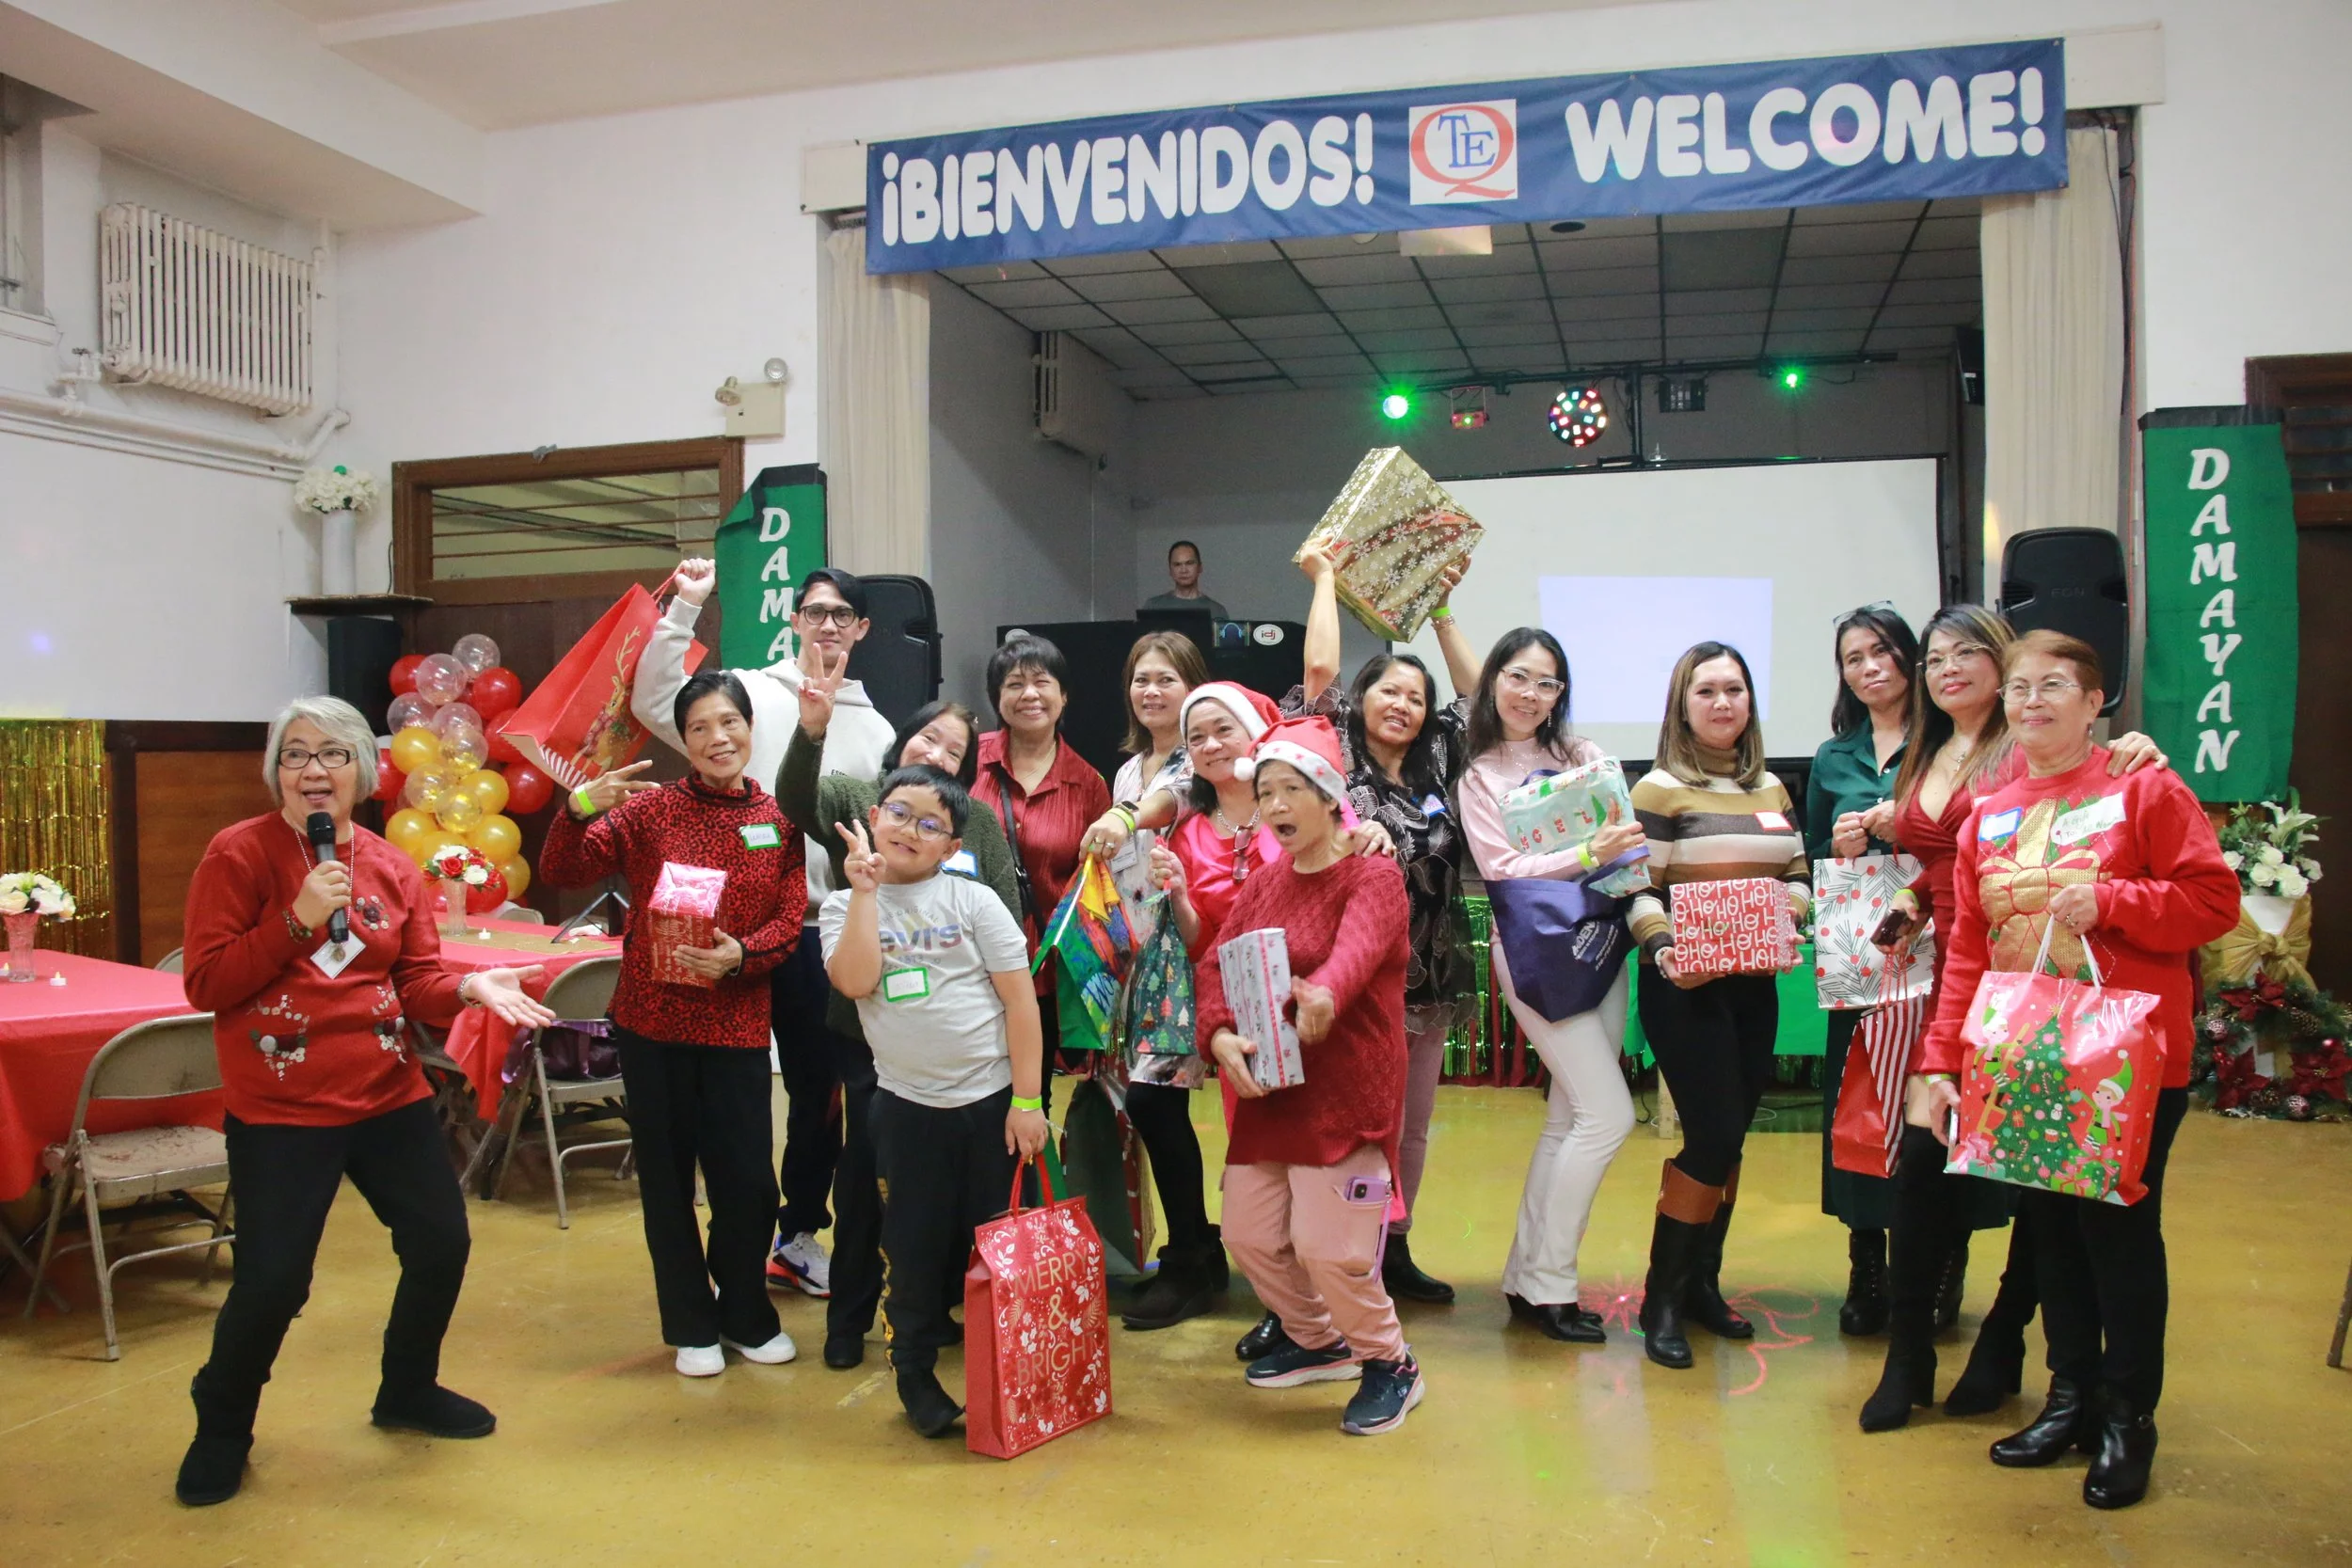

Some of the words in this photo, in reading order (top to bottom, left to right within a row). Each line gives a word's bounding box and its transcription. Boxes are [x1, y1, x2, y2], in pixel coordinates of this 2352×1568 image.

[1565, 66, 2046, 183] WELCOME!
[882, 112, 1374, 246] ¡BIENVENIDOS!
[2187, 448, 2243, 774] DAMAYAN
[1015, 1246, 1089, 1298] MERRY
[1047, 1293, 1069, 1330] &
[1017, 1330, 1100, 1387] BRIGHT
